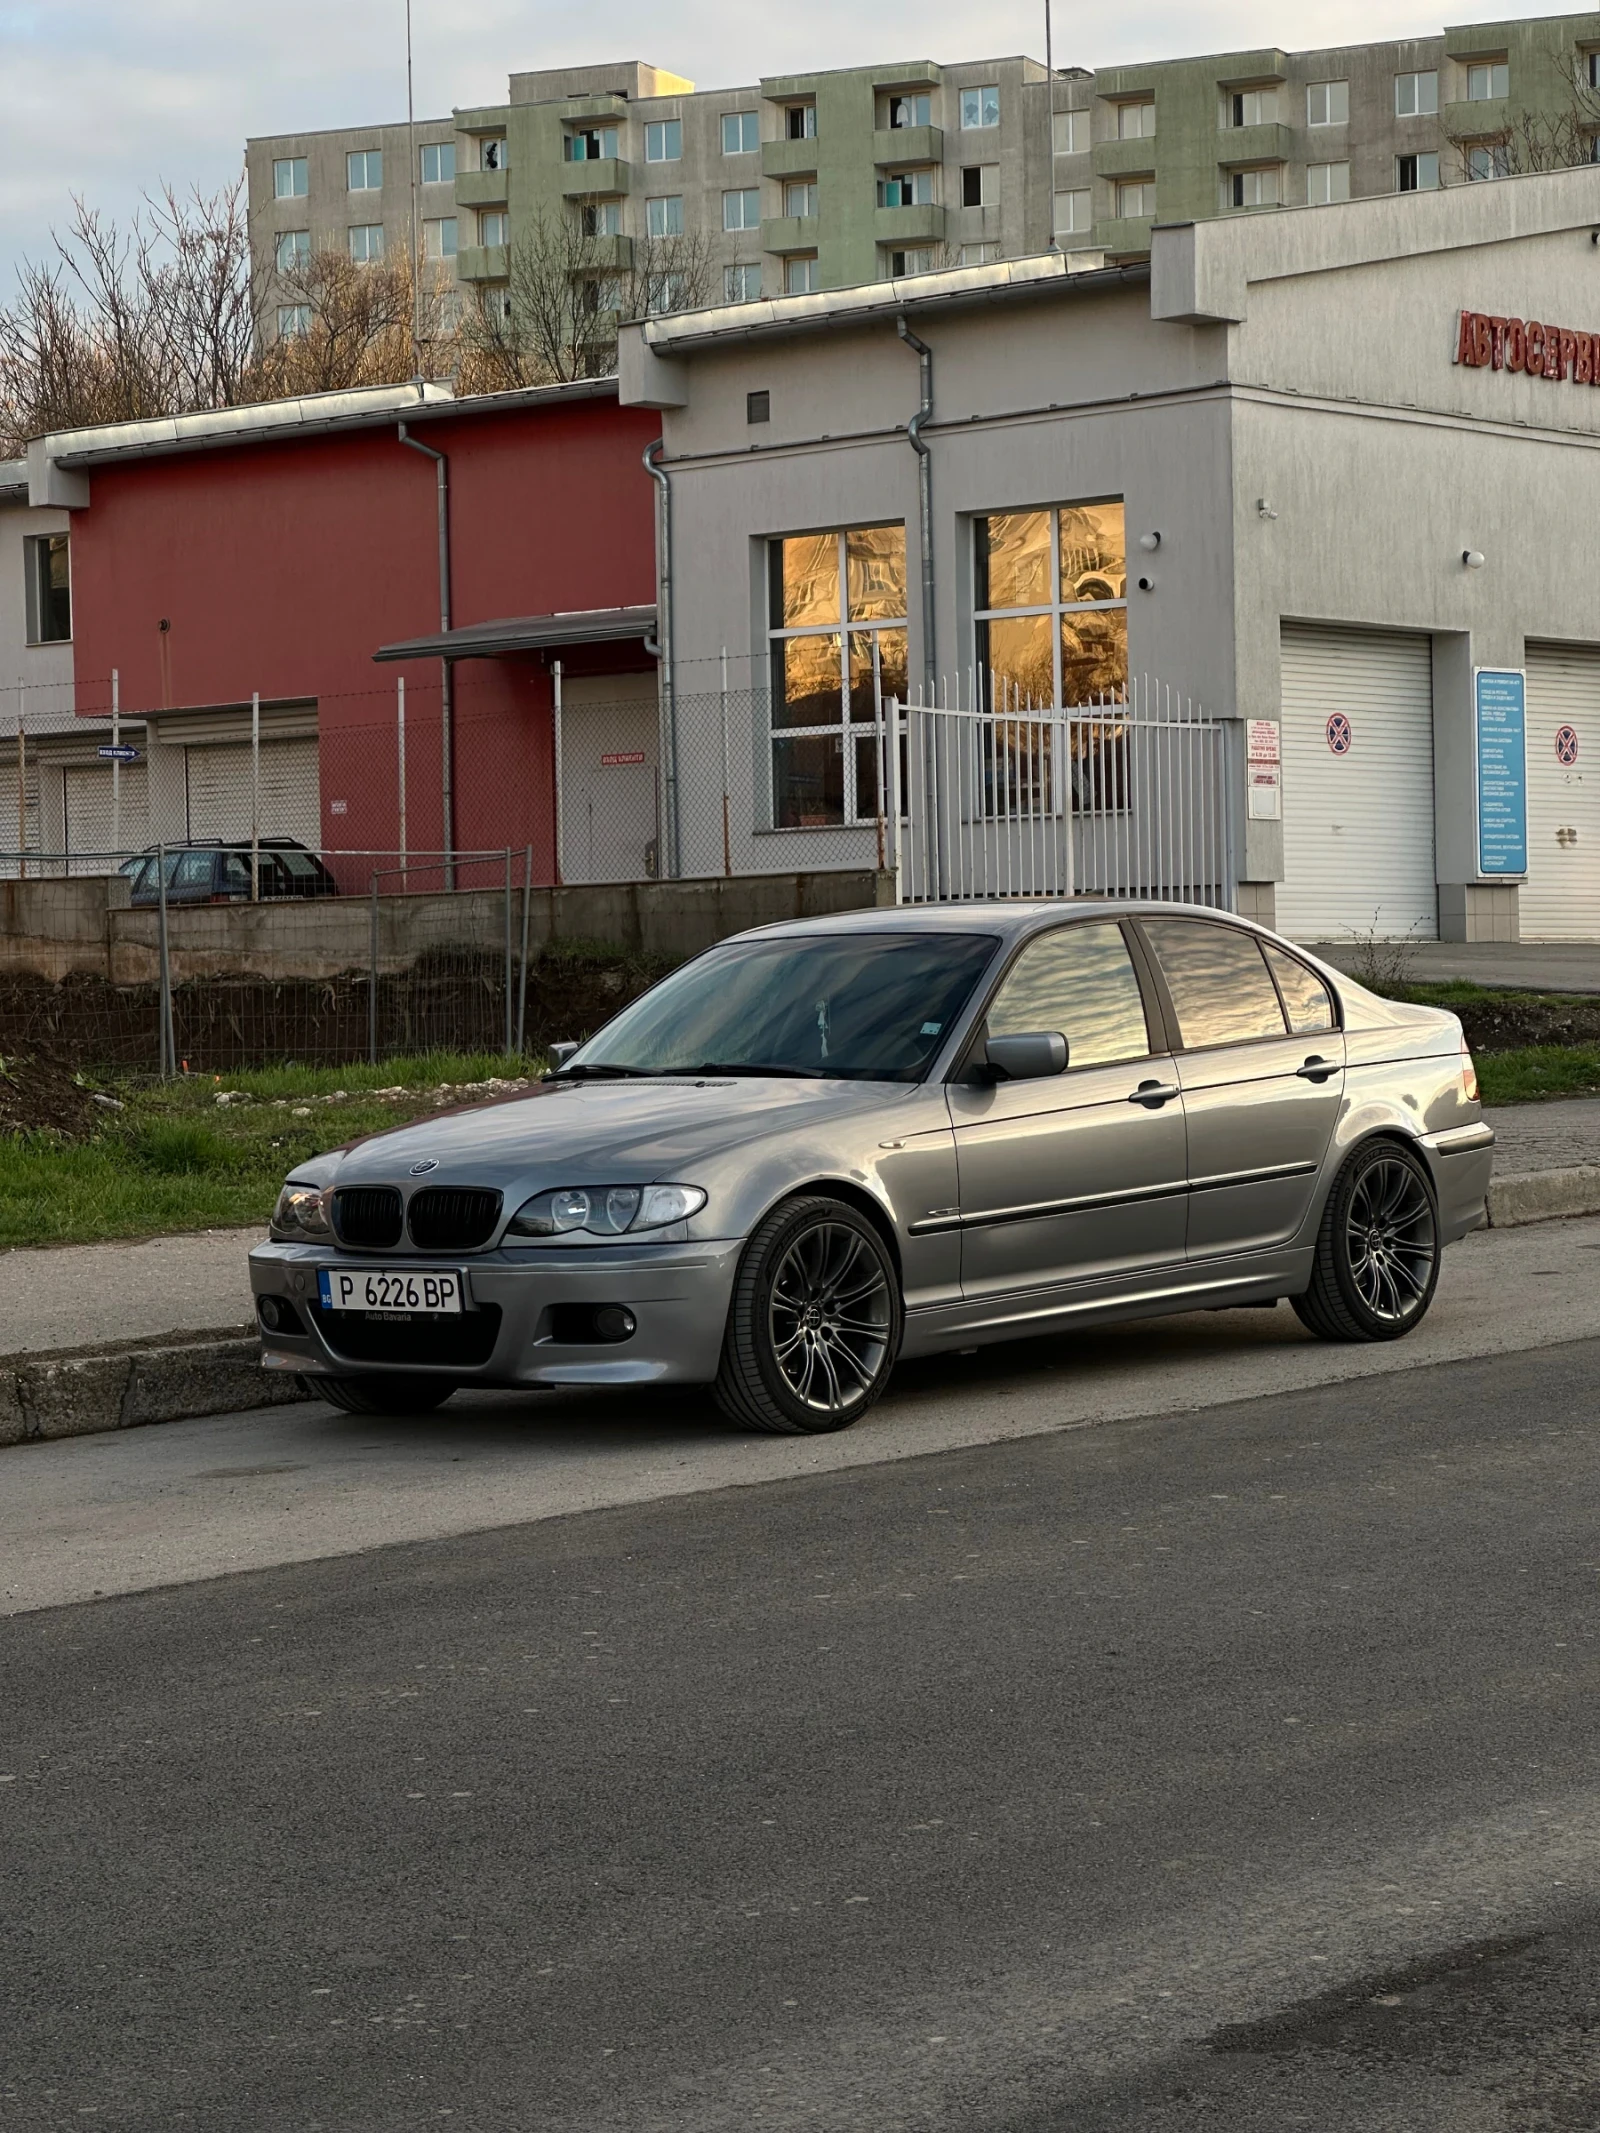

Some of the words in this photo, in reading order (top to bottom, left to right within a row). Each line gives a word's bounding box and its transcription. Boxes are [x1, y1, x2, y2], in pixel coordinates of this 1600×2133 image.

[339, 1275, 354, 1305] P
[365, 1276, 420, 1307] 6226
[423, 1278, 455, 1308] BP
[322, 1294, 332, 1303] BG
[365, 1311, 383, 1320] Auto
[383, 1312, 412, 1321] Bavaria
